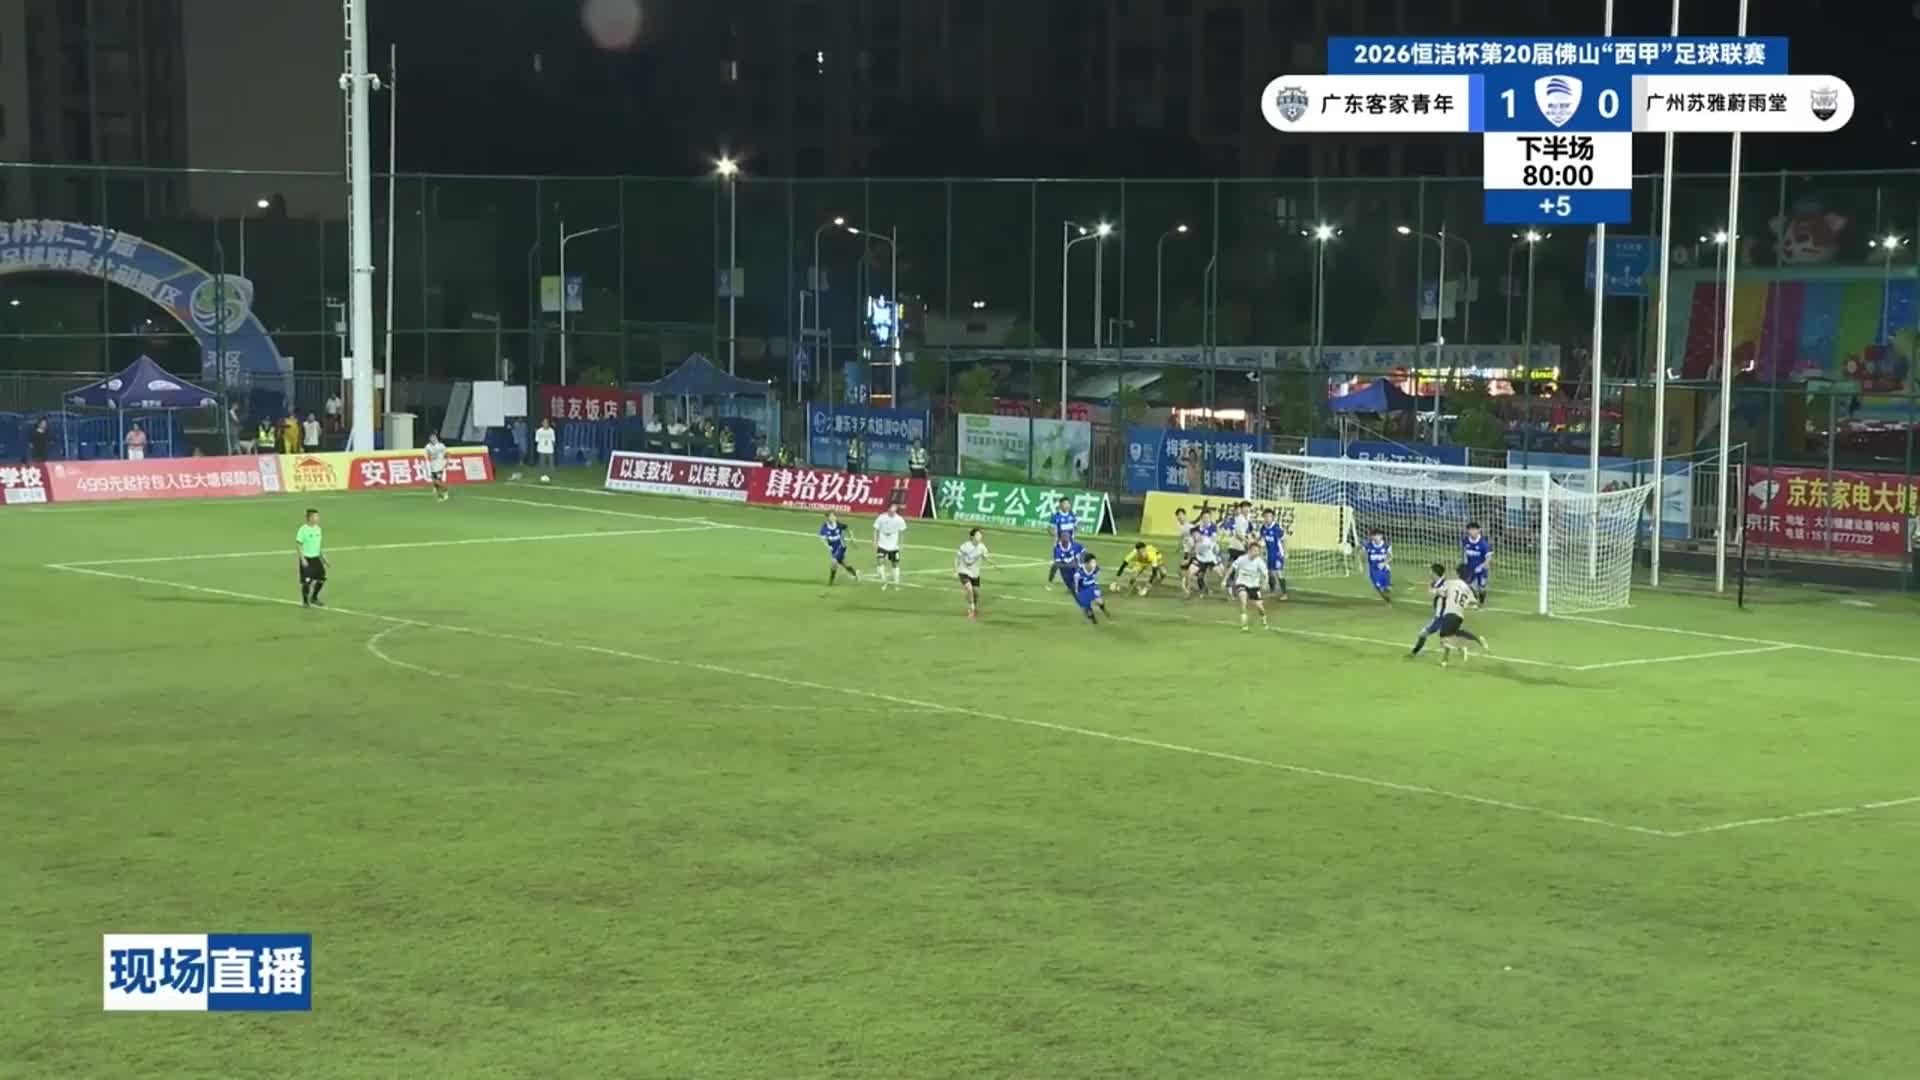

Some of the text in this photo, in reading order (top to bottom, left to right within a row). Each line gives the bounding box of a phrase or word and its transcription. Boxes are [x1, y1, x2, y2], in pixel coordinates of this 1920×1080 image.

[765, 469, 872, 504] 肆拾玖坊
[938, 480, 1100, 523] 洪七公农庄
